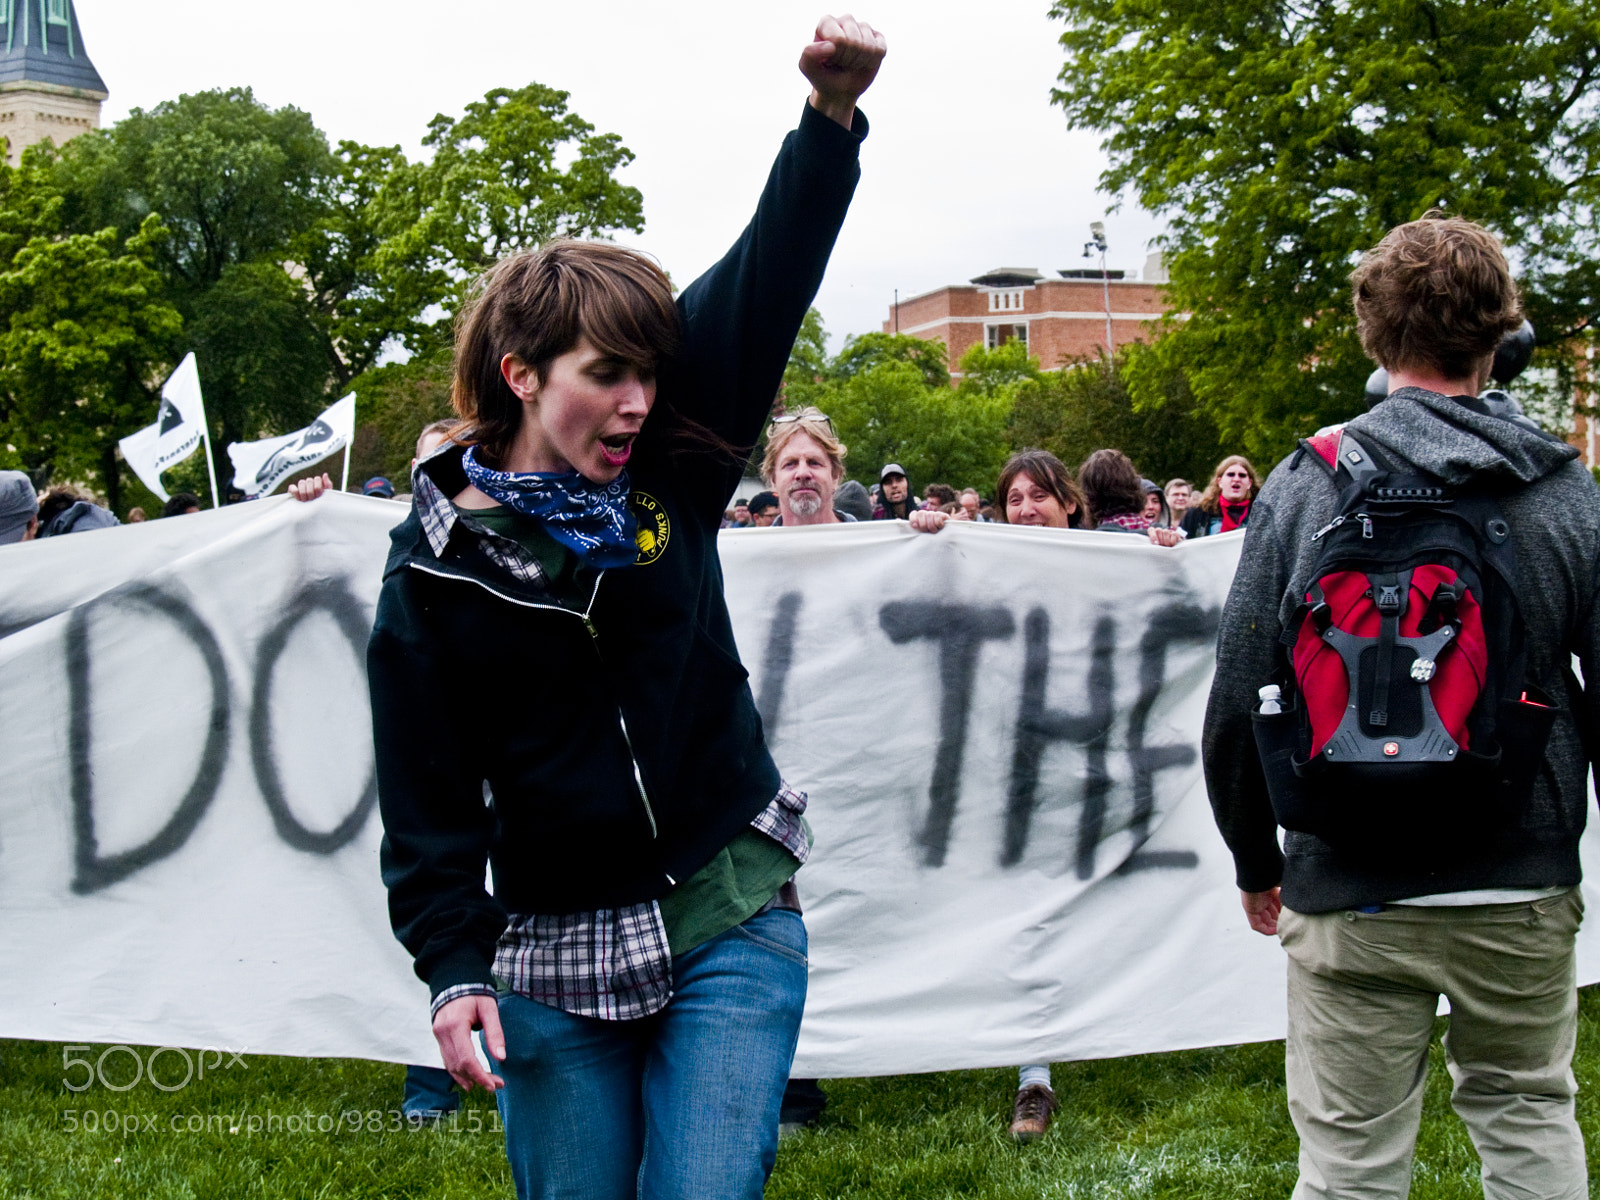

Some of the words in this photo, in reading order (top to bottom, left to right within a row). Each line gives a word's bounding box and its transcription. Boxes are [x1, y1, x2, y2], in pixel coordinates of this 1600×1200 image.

[636, 495, 656, 510] LLO
[656, 513, 667, 547] PUNKS
[879, 600, 1222, 881] THE
